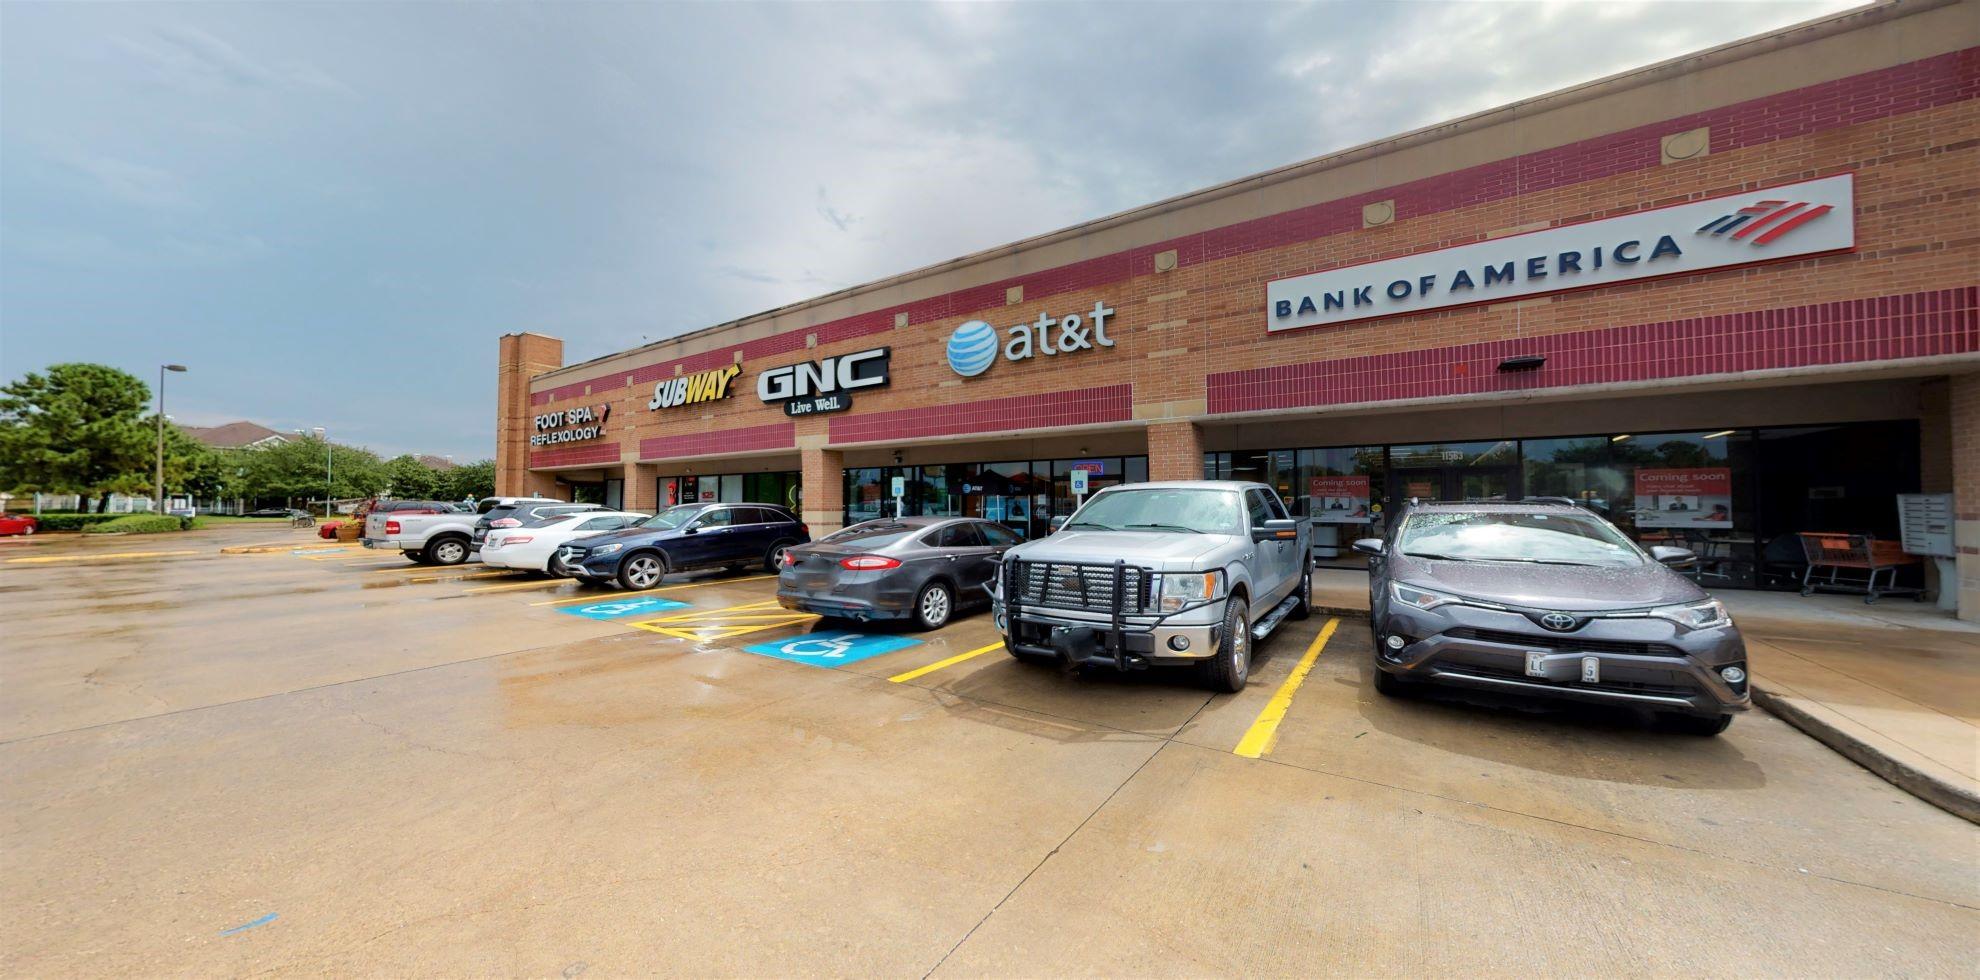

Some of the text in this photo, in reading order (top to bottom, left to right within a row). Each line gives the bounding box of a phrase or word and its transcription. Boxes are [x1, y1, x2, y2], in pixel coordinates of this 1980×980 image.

[1275, 234, 1683, 318] BANK OF AMERICA
[1004, 301, 1115, 361] at&t
[648, 363, 742, 411] SUBWAY
[757, 348, 886, 401] GNC
[791, 396, 841, 414] Live Well.
[535, 406, 593, 432] FOOT SPA
[530, 425, 599, 446] REFLEXOLOGY
[1312, 479, 1344, 488] Coming
[1640, 472, 1726, 482] Coming soon
